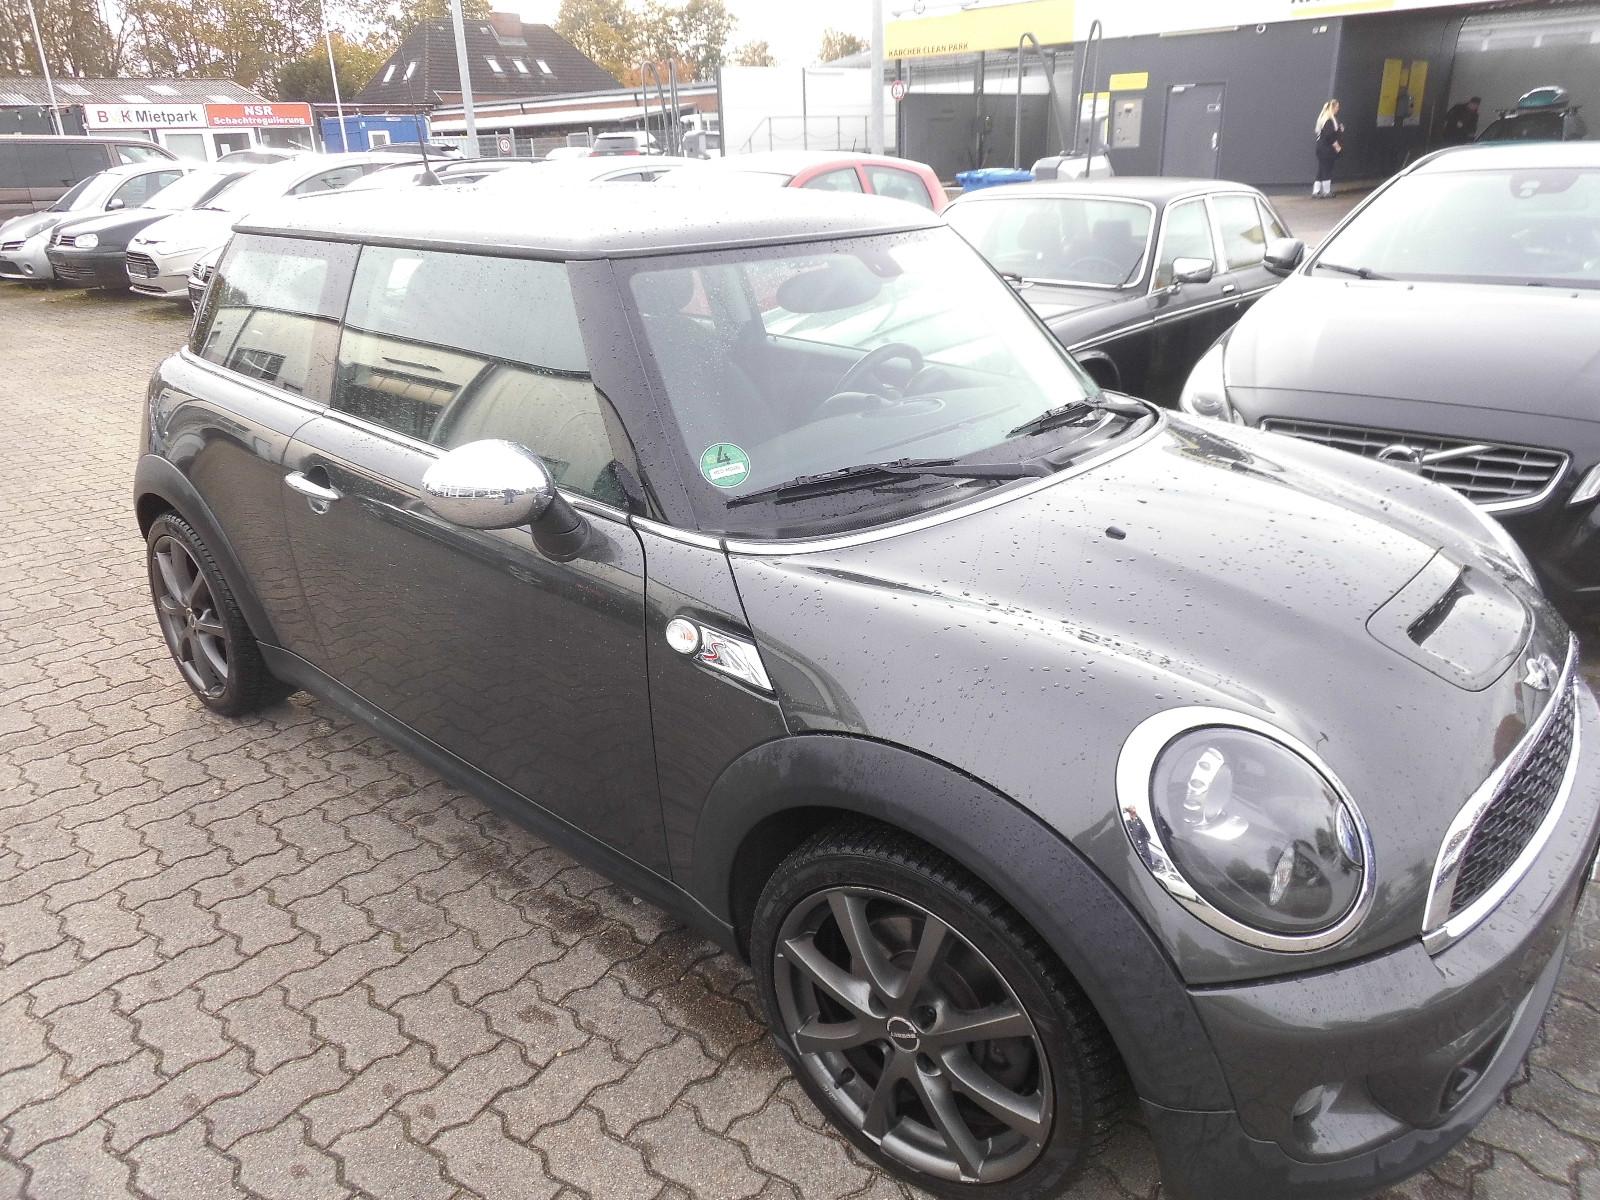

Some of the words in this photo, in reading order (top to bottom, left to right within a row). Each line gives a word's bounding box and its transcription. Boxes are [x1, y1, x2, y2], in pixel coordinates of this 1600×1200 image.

[923, 43, 946, 54] CLEAN
[949, 41, 969, 51] PARK
[244, 105, 274, 117] NSR
[136, 110, 198, 126] Mietpark
[213, 116, 305, 126] Schachtregulierung
